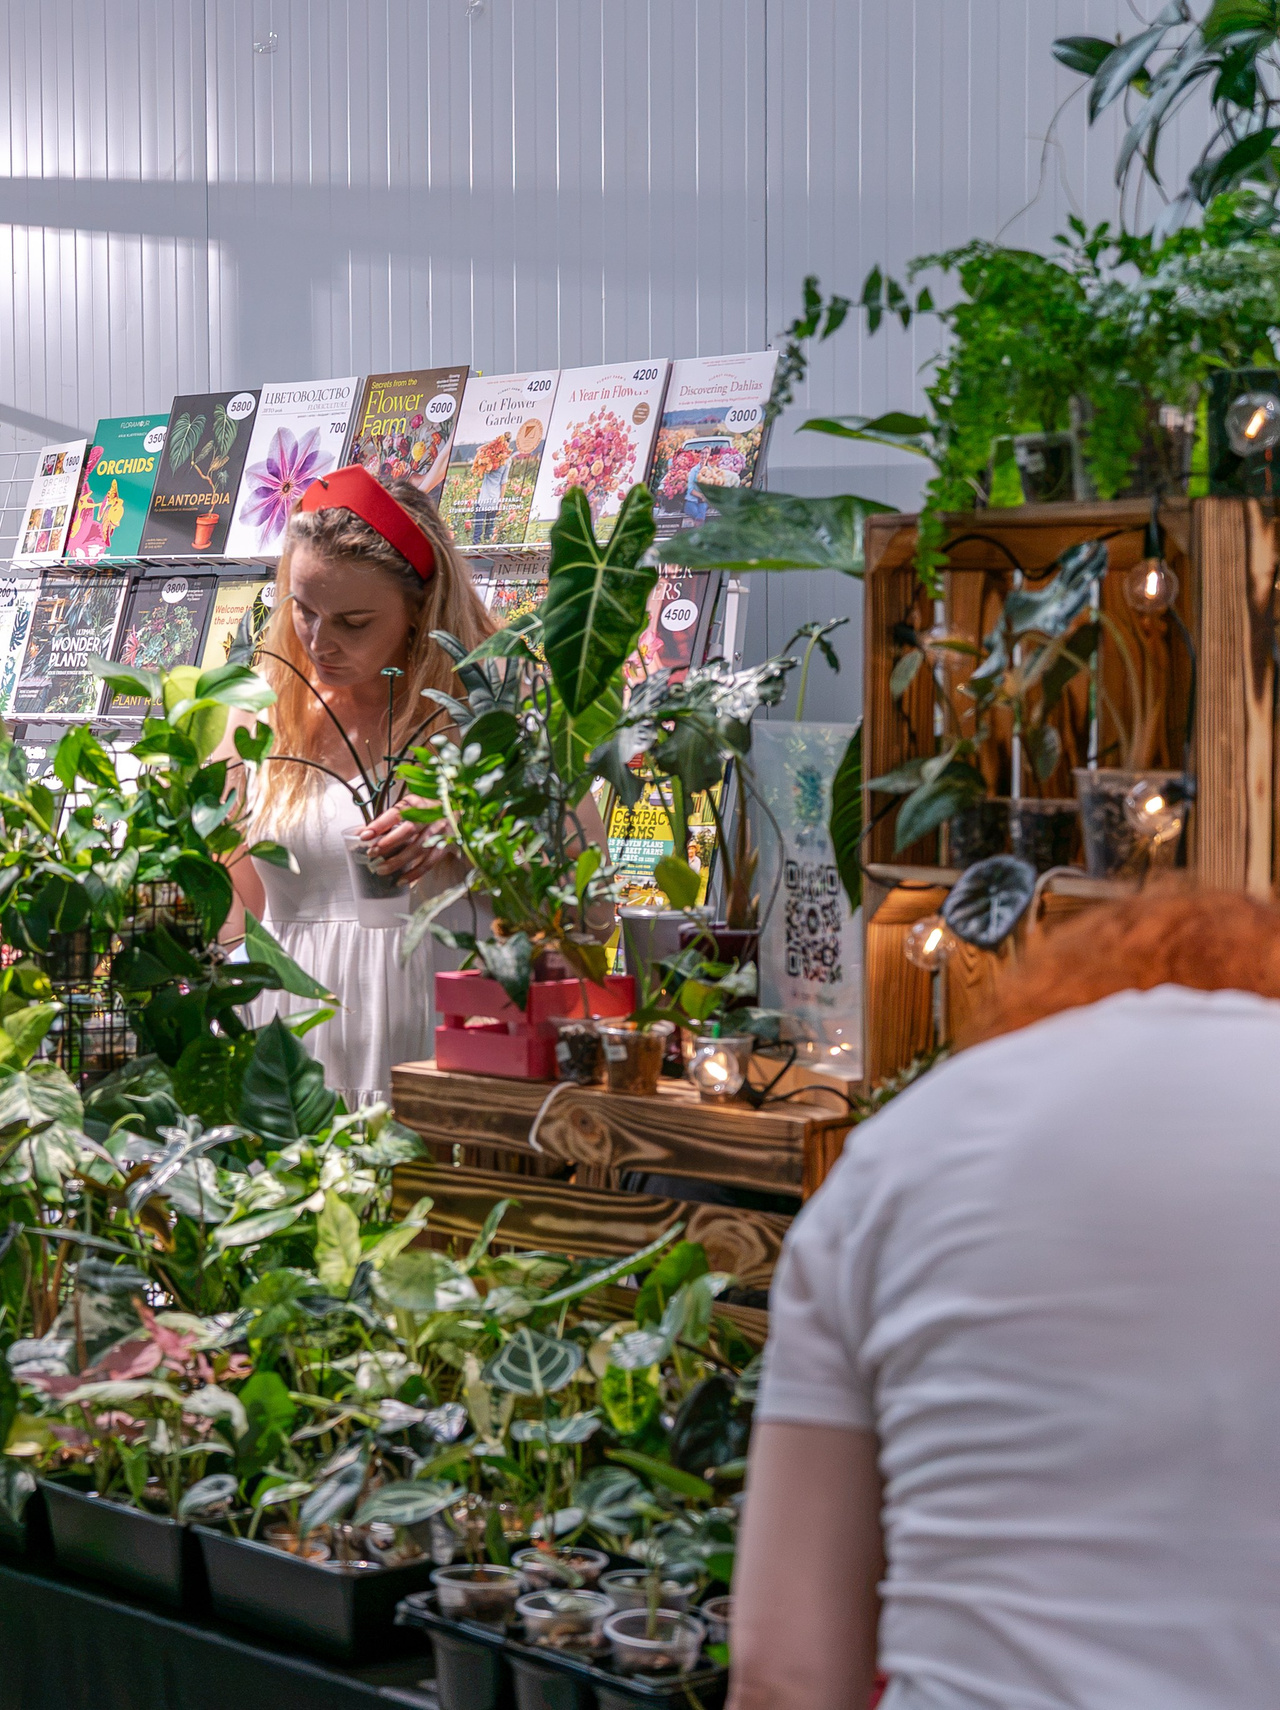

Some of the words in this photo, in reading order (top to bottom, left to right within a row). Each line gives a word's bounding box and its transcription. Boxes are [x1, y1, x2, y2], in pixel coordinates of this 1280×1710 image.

[633, 368, 658, 380] 4200
[371, 380, 392, 389] Secrets
[393, 379, 407, 387] from
[407, 378, 418, 386] the
[527, 380, 552, 392] 4200
[679, 384, 728, 396] Discovering
[730, 379, 763, 392] Dahlias
[264, 386, 351, 405] ЦВЕТОВОДСТВО
[366, 389, 424, 415] Flower
[568, 390, 576, 403] A
[579, 388, 600, 402] Year
[600, 387, 611, 400] in
[230, 401, 252, 412] 5800
[429, 402, 452, 413] 5000
[479, 399, 497, 412] Cut
[500, 397, 537, 410] Flower
[485, 412, 523, 426] Garden
[730, 408, 757, 422] 3000
[329, 422, 347, 434] 700
[361, 414, 407, 437] Farm
[96, 457, 155, 475] ORCHIDS
[154, 492, 230, 507] PLANTOPEDIA
[498, 564, 512, 575] IN
[516, 563, 538, 575] THE
[166, 583, 186, 594] 3800
[215, 605, 244, 614] Welcome
[664, 609, 691, 621] 4500
[214, 617, 225, 625] the
[51, 636, 100, 652] WONDER
[48, 652, 89, 667] PLANTS
[112, 695, 143, 706] PLANT
[614, 810, 671, 826] COMPAC
[611, 825, 656, 840] FARMS
[616, 846, 642, 854] MRKET
[642, 847, 664, 855] FARMS
